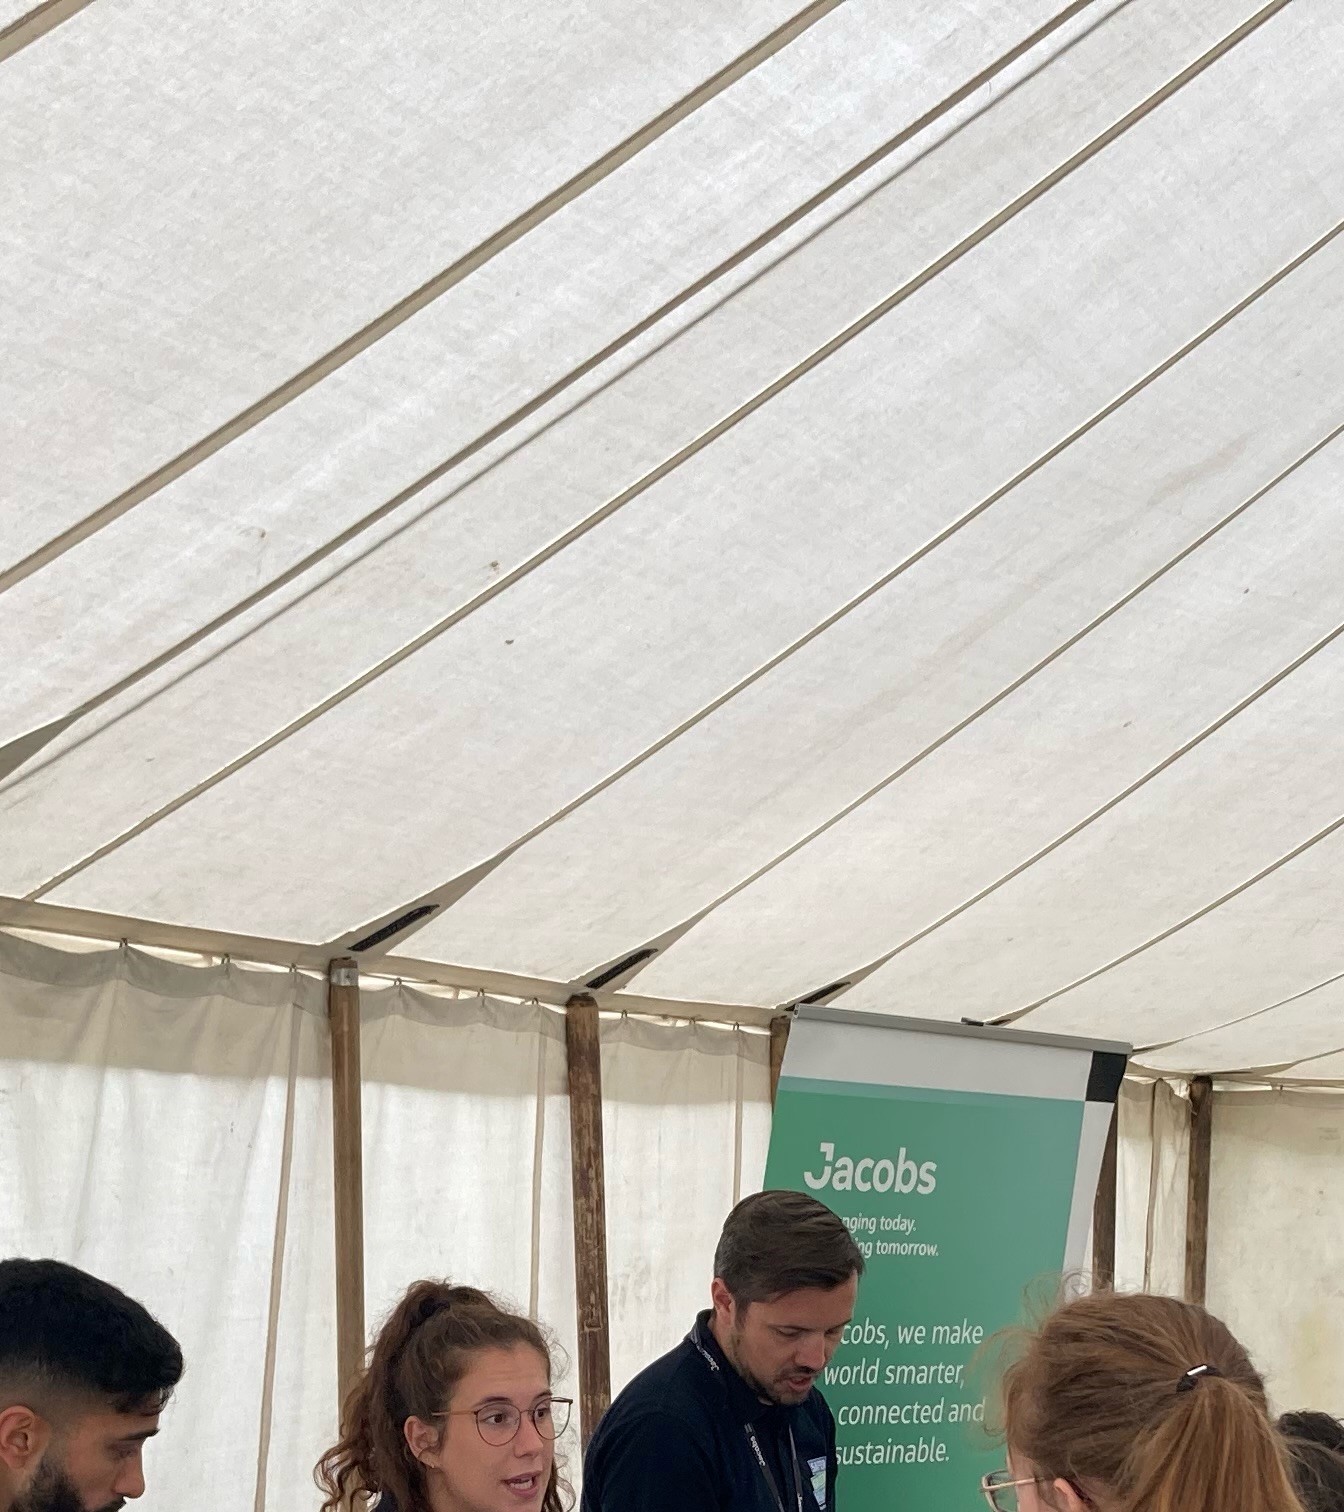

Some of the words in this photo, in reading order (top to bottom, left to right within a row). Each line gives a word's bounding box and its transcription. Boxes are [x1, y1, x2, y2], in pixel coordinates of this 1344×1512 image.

[804, 1142, 937, 1195] Jacobs
[841, 1212, 876, 1234] nging
[880, 1214, 916, 1235] today.
[876, 1240, 939, 1257] tomorrow.
[840, 1317, 889, 1349] cobs,
[897, 1324, 926, 1345] we
[932, 1318, 984, 1345] make
[824, 1357, 880, 1386] world
[884, 1363, 965, 1389] smarter,
[838, 1397, 945, 1426] connected
[948, 1396, 986, 1423] and
[835, 1436, 950, 1465] sustainable.
